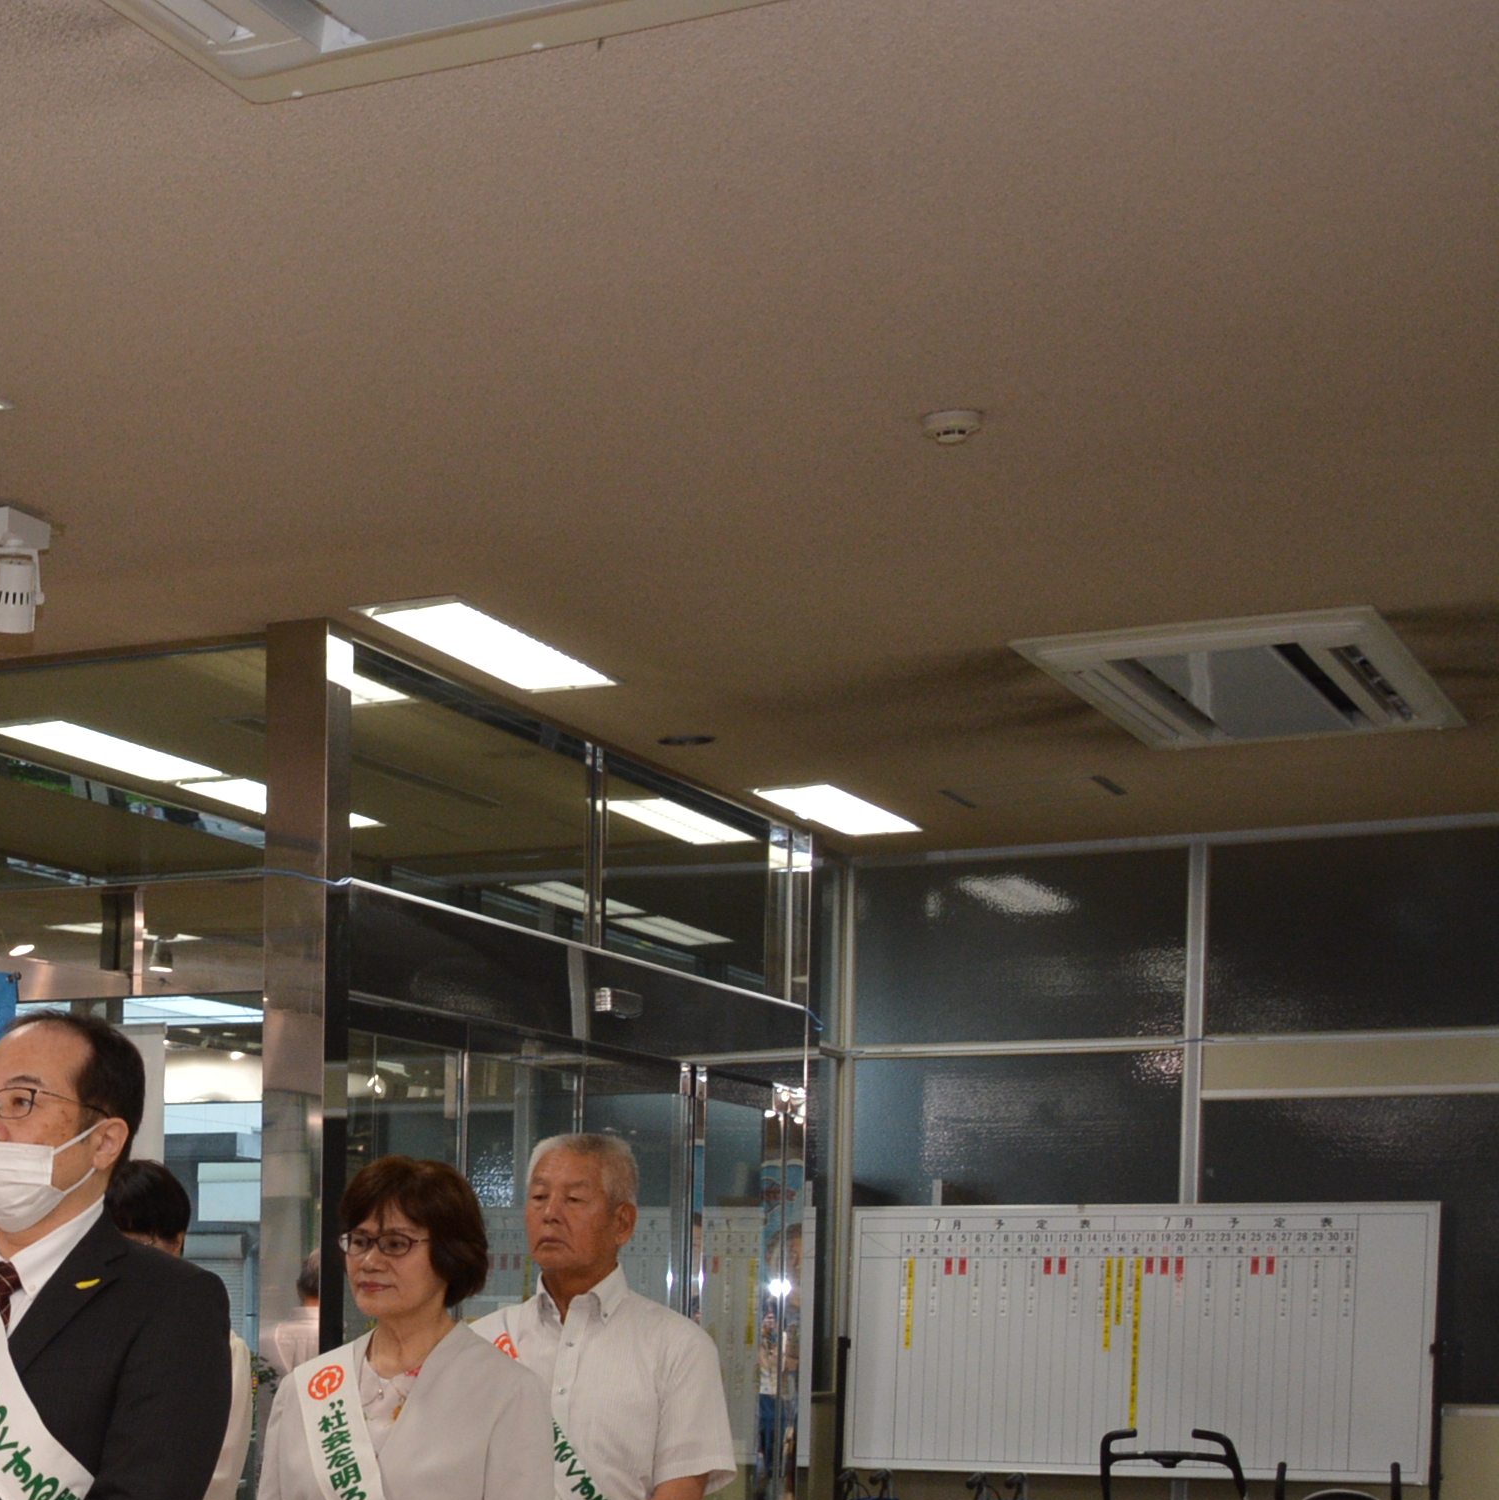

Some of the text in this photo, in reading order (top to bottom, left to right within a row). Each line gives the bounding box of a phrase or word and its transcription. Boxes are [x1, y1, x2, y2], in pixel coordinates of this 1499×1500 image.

[1030, 1234, 1039, 1243] 10
[1044, 1234, 1053, 1243] 11
[1058, 1233, 1068, 1243] 12
[1073, 1233, 1082, 1242] 13
[1087, 1233, 1097, 1242] 14
[1103, 1233, 1112, 1242] 15
[1117, 1233, 1126, 1242] 16
[1131, 1233, 1141, 1242] 17
[1146, 1233, 1156, 1242] 18
[1161, 1233, 1170, 1242] 19
[1175, 1233, 1185, 1242] 20
[1190, 1233, 1200, 1242] 21
[1205, 1233, 1215, 1242] 22
[1220, 1233, 1231, 1242] 23
[1235, 1232, 1246, 1242] 24
[1250, 1232, 1261, 1242] 25
[1266, 1232, 1277, 1242] 26
[1281, 1232, 1292, 1242] 27
[1296, 1232, 1307, 1242] 28
[1312, 1232, 1323, 1242] 29
[1328, 1232, 1339, 1242] 30
[1343, 1232, 1353, 1242] 31
